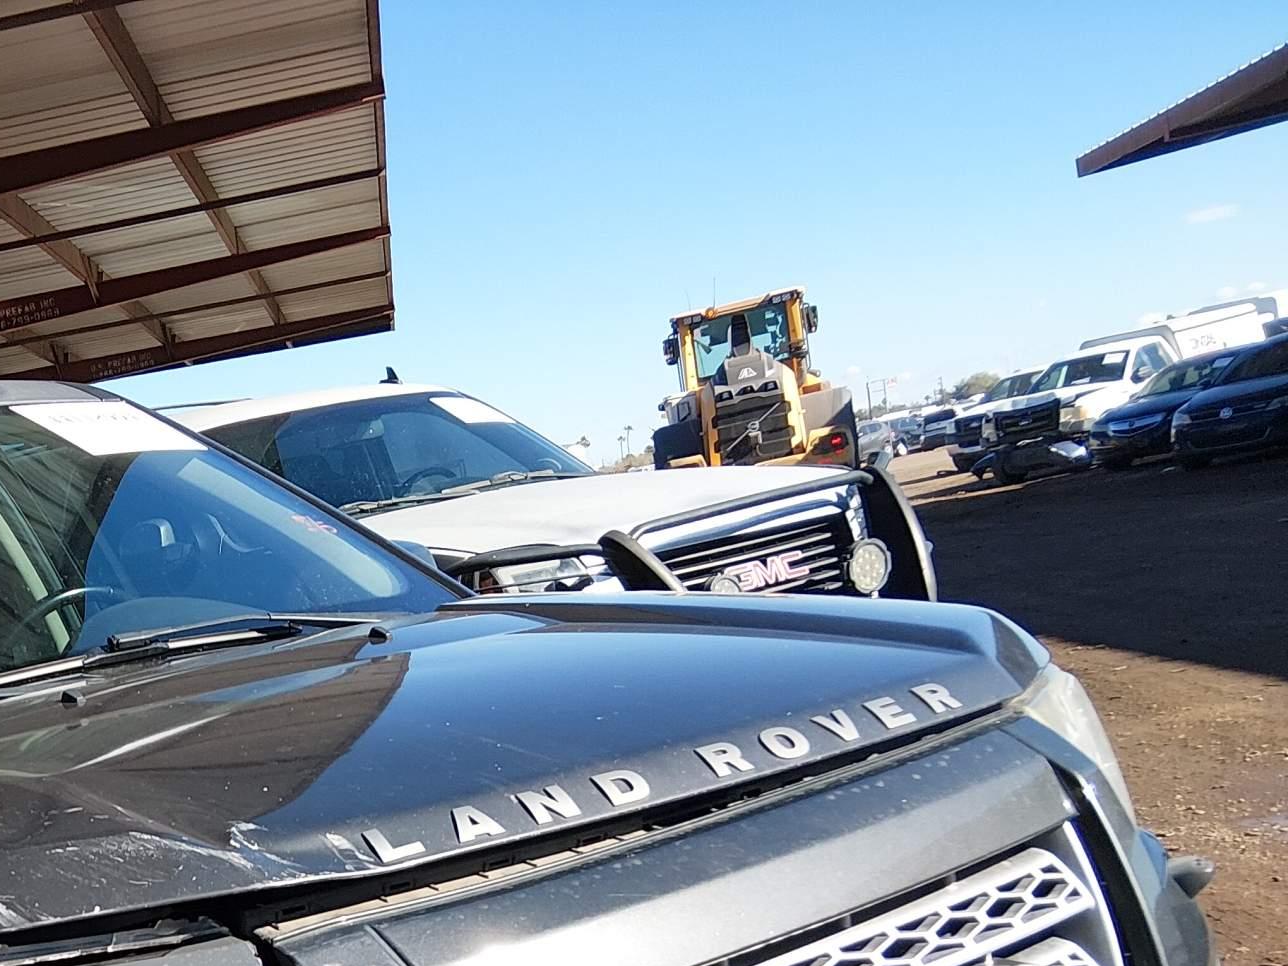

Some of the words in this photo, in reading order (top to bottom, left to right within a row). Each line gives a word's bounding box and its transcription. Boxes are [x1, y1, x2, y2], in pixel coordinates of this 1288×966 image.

[724, 550, 810, 591] GMC
[362, 769, 651, 864] LAND
[694, 682, 962, 778] ROVER
